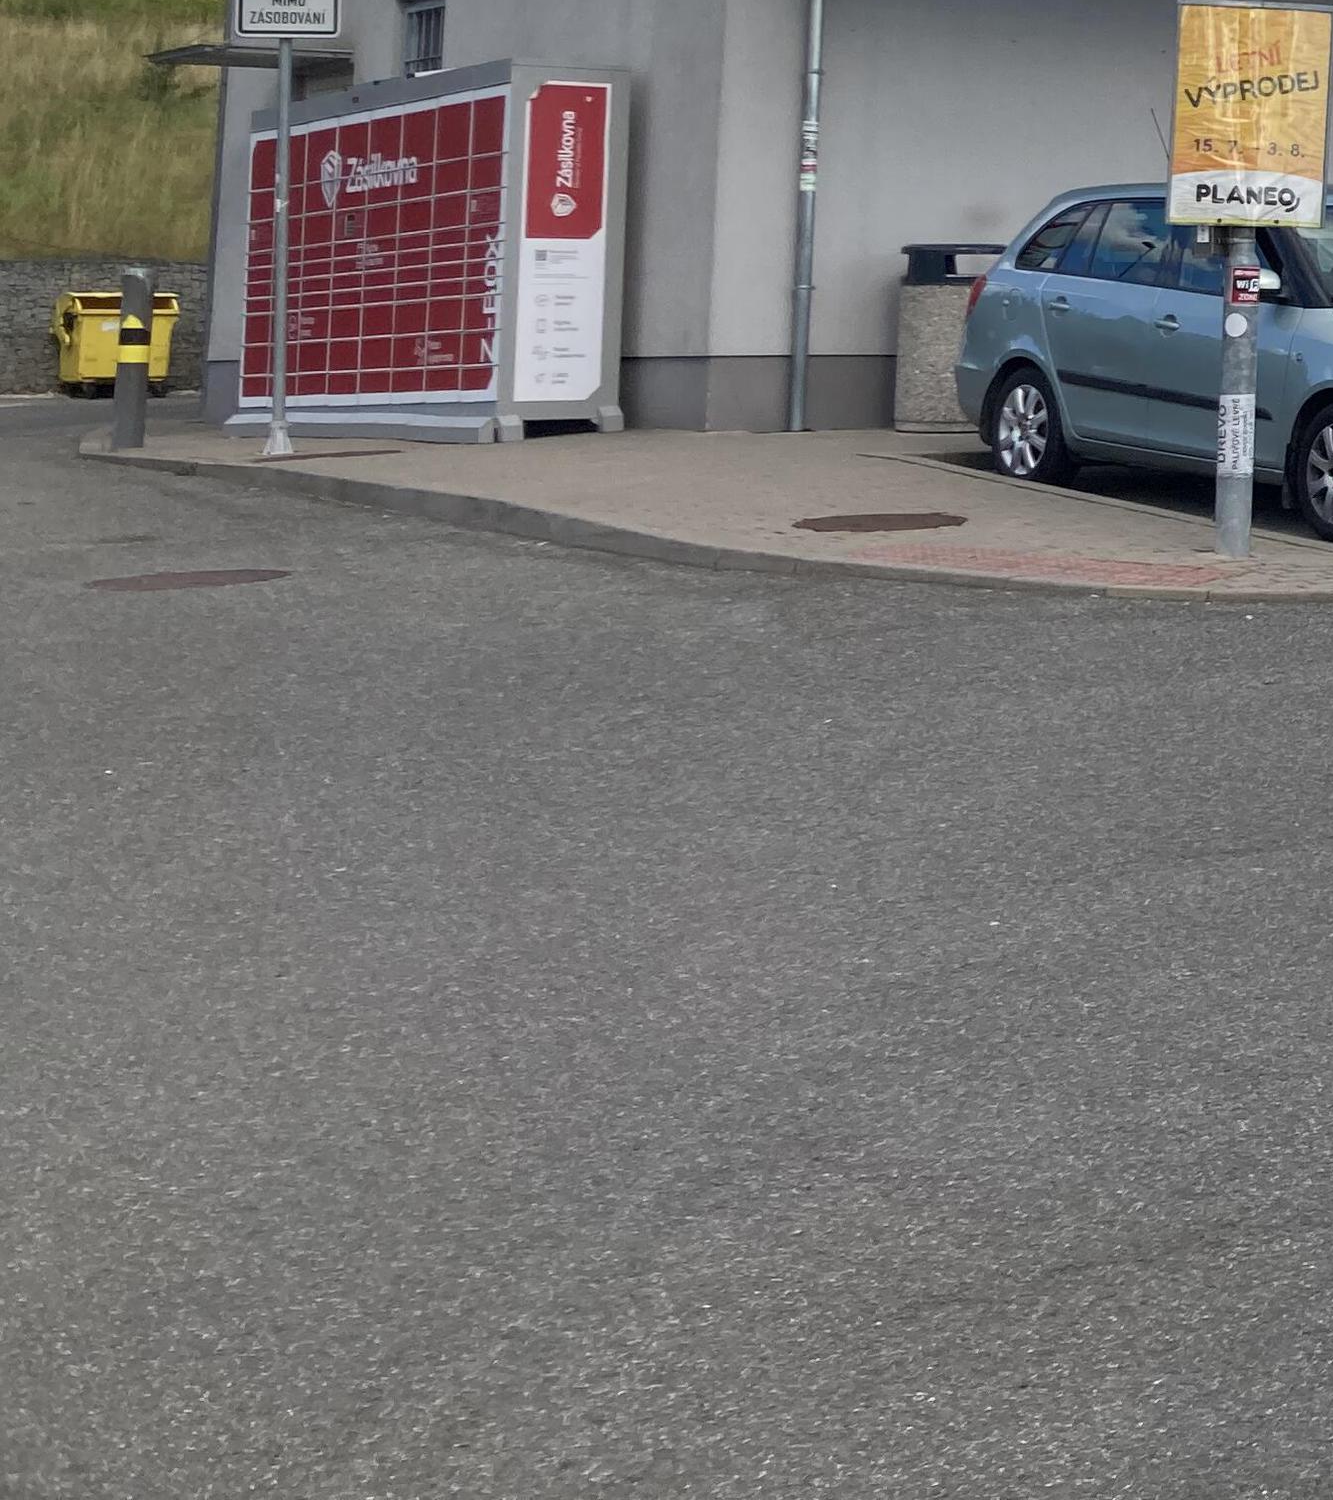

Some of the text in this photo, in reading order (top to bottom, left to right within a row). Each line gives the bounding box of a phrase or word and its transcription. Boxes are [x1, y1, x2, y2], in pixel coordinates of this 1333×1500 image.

[249, 7, 326, 25] ZÁSOBOVÁNÍ
[1184, 69, 1320, 109] VÝPRODEJ
[555, 110, 576, 188] Zásilkovna
[1290, 143, 1305, 158] 8.
[346, 153, 418, 194] Zásilkovna
[1195, 183, 1300, 211] PLANEO
